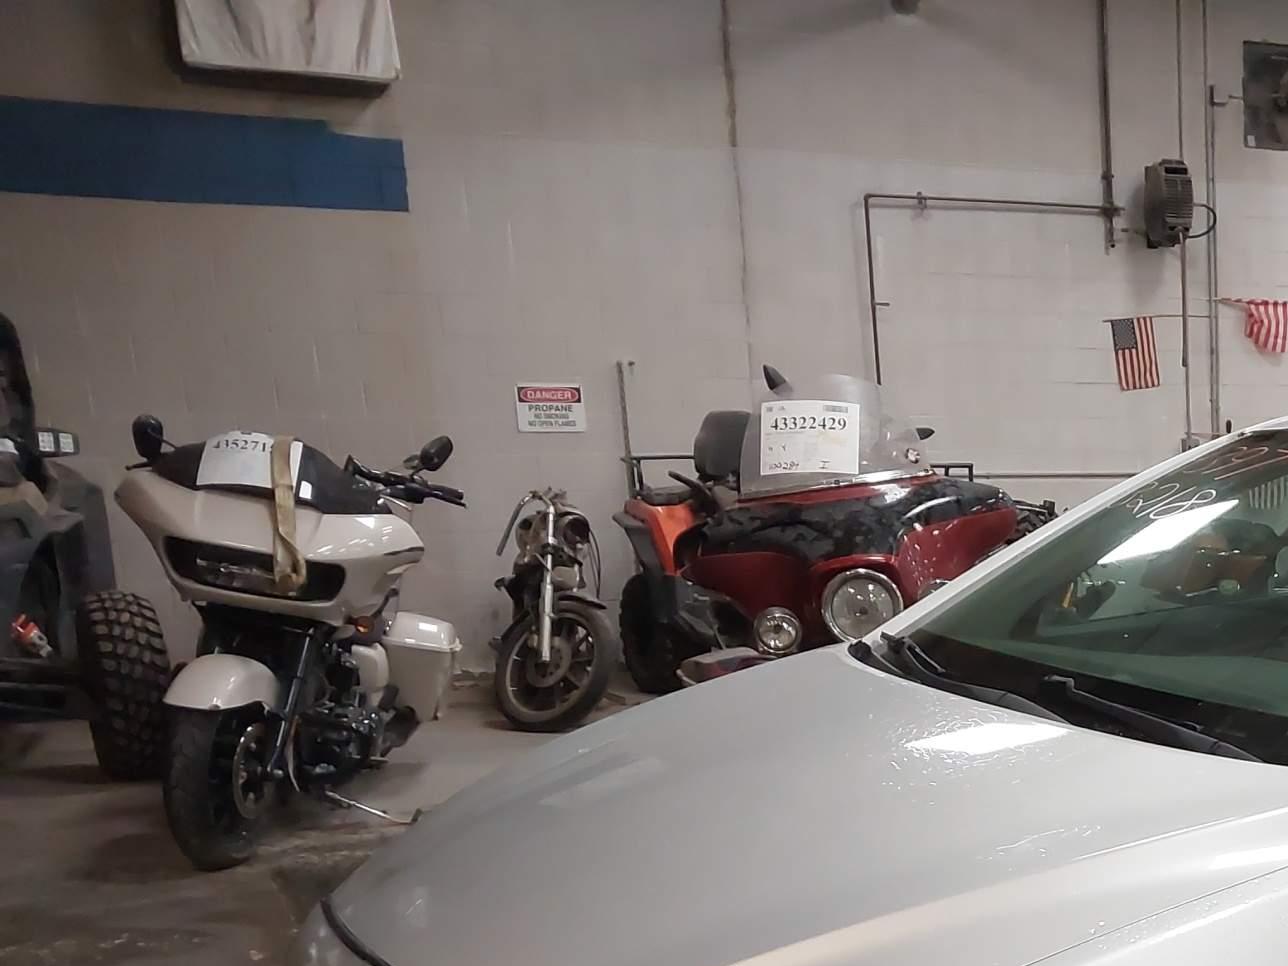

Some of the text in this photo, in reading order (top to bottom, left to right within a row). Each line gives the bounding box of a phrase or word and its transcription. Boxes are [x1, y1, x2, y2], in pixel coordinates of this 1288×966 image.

[527, 390, 573, 400] DANGER
[528, 404, 573, 413] PROPANE
[770, 416, 848, 431] 43322429
[212, 439, 273, 453] 435271
